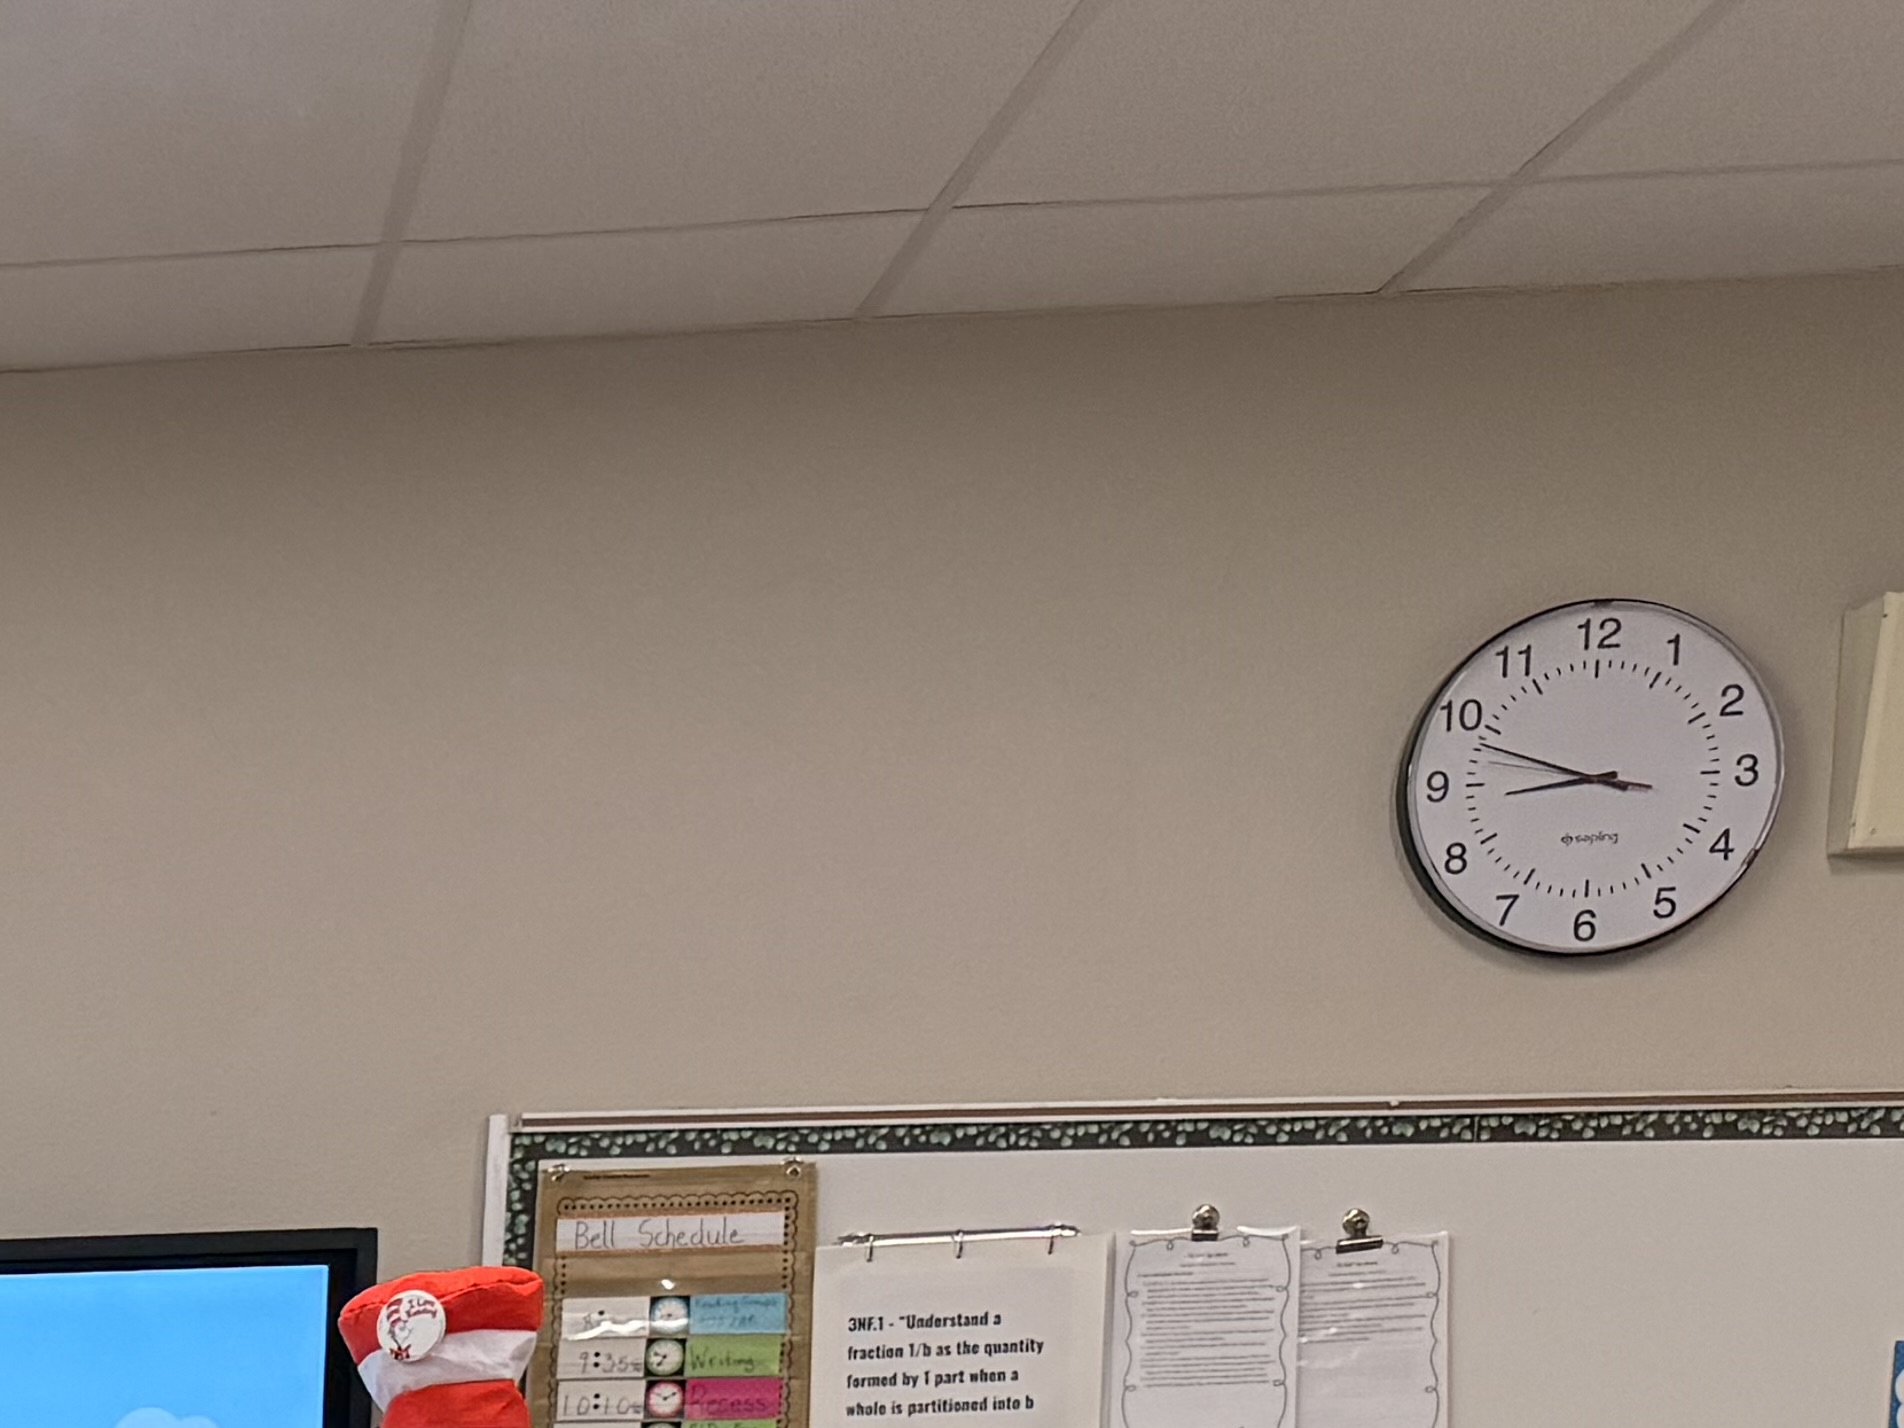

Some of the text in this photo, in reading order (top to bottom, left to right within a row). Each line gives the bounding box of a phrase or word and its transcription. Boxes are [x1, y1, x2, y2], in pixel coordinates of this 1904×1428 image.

[1578, 618, 1622, 650] 12
[1667, 634, 1680, 666] 1
[1496, 645, 1532, 678] 11
[1440, 699, 1483, 732] 10
[1720, 684, 1745, 717] 2
[1735, 754, 1759, 786] 3
[1426, 771, 1450, 803] 9
[1444, 843, 1467, 875] 8
[1709, 828, 1734, 861] 4
[1496, 895, 1520, 926] 7
[1653, 887, 1677, 919] 5
[1573, 910, 1597, 941] 6
[575, 1218, 746, 1249] Bell Schedule
[848, 1339, 1044, 1361] fraction 1/b as the quantity
[847, 1370, 1006, 1390] formed by part when
[846, 1397, 1020, 1417] whole is partitioned into
